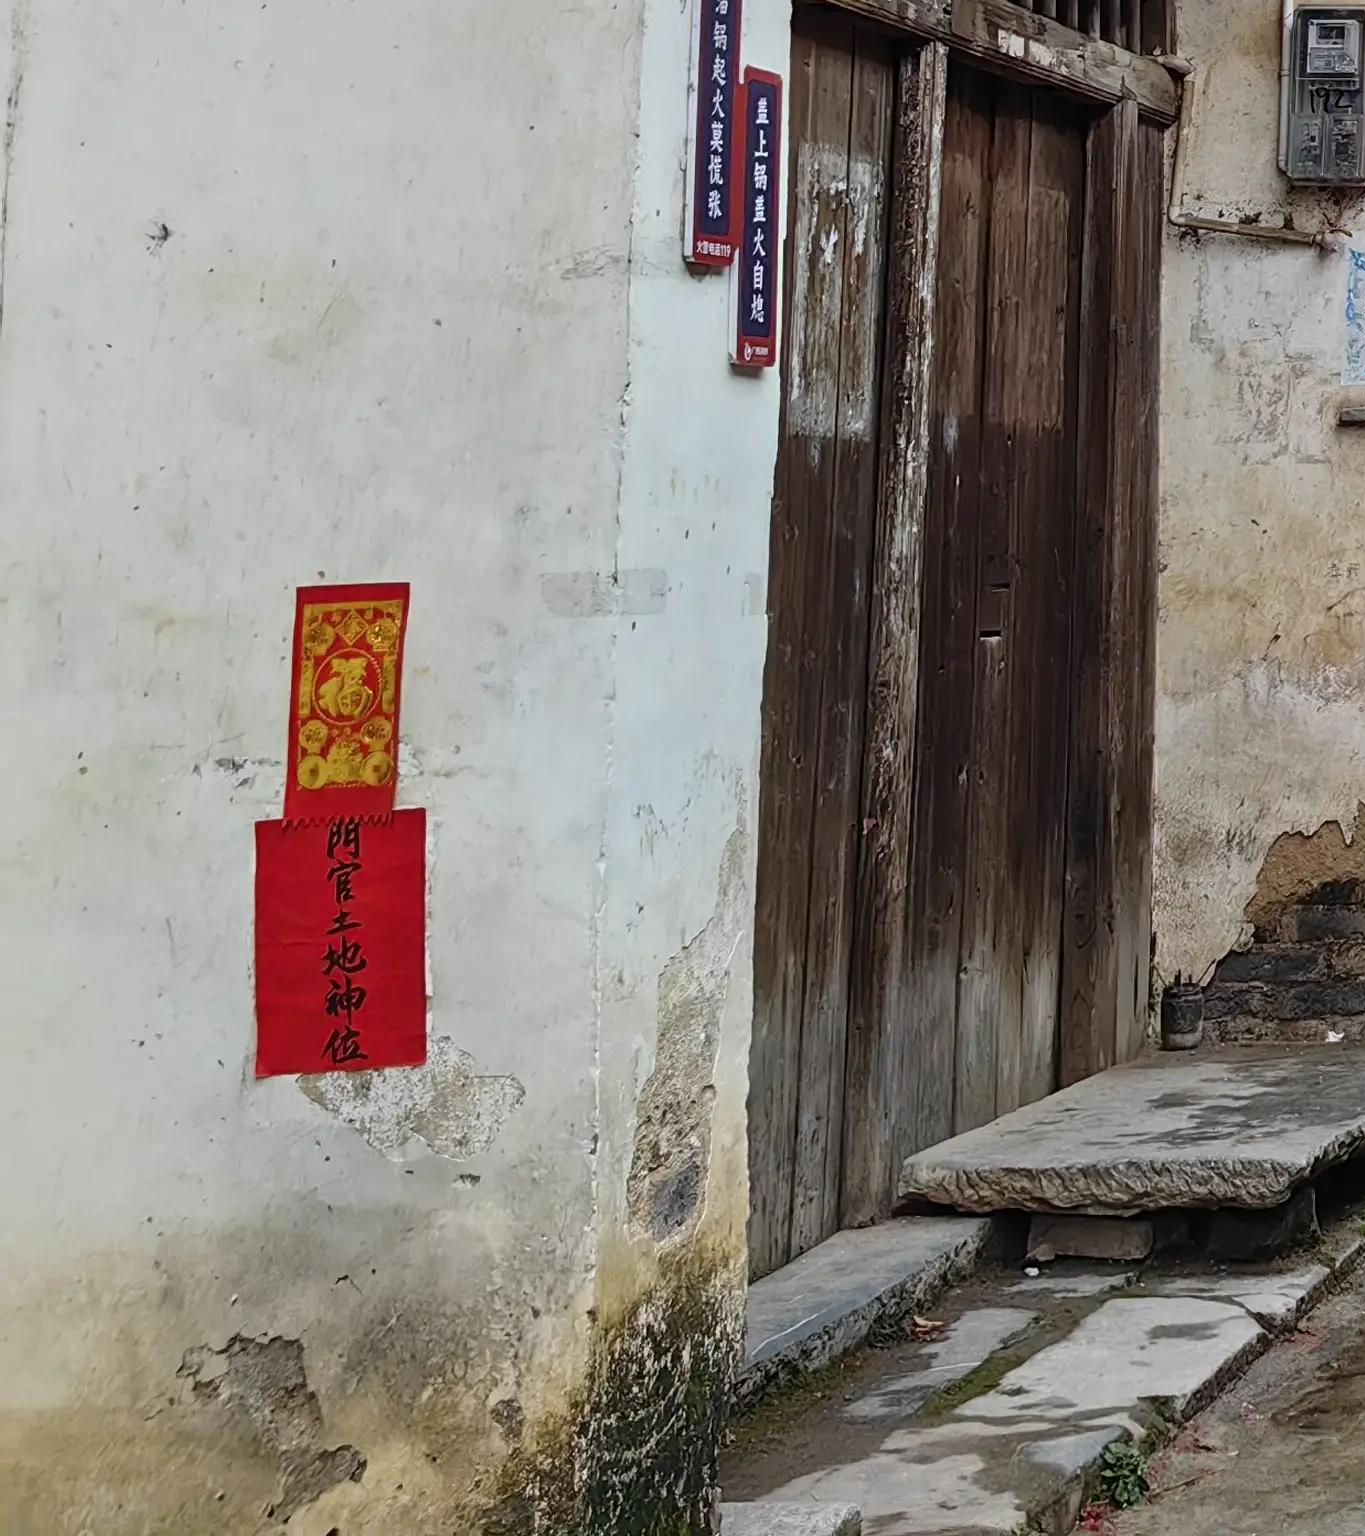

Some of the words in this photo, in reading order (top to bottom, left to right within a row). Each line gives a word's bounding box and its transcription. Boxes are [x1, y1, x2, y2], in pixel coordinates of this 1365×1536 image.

[750, 96, 768, 323] 盖上锅盖火自熄
[319, 658, 373, 717] 福
[321, 816, 369, 1065] 門官土地神位
